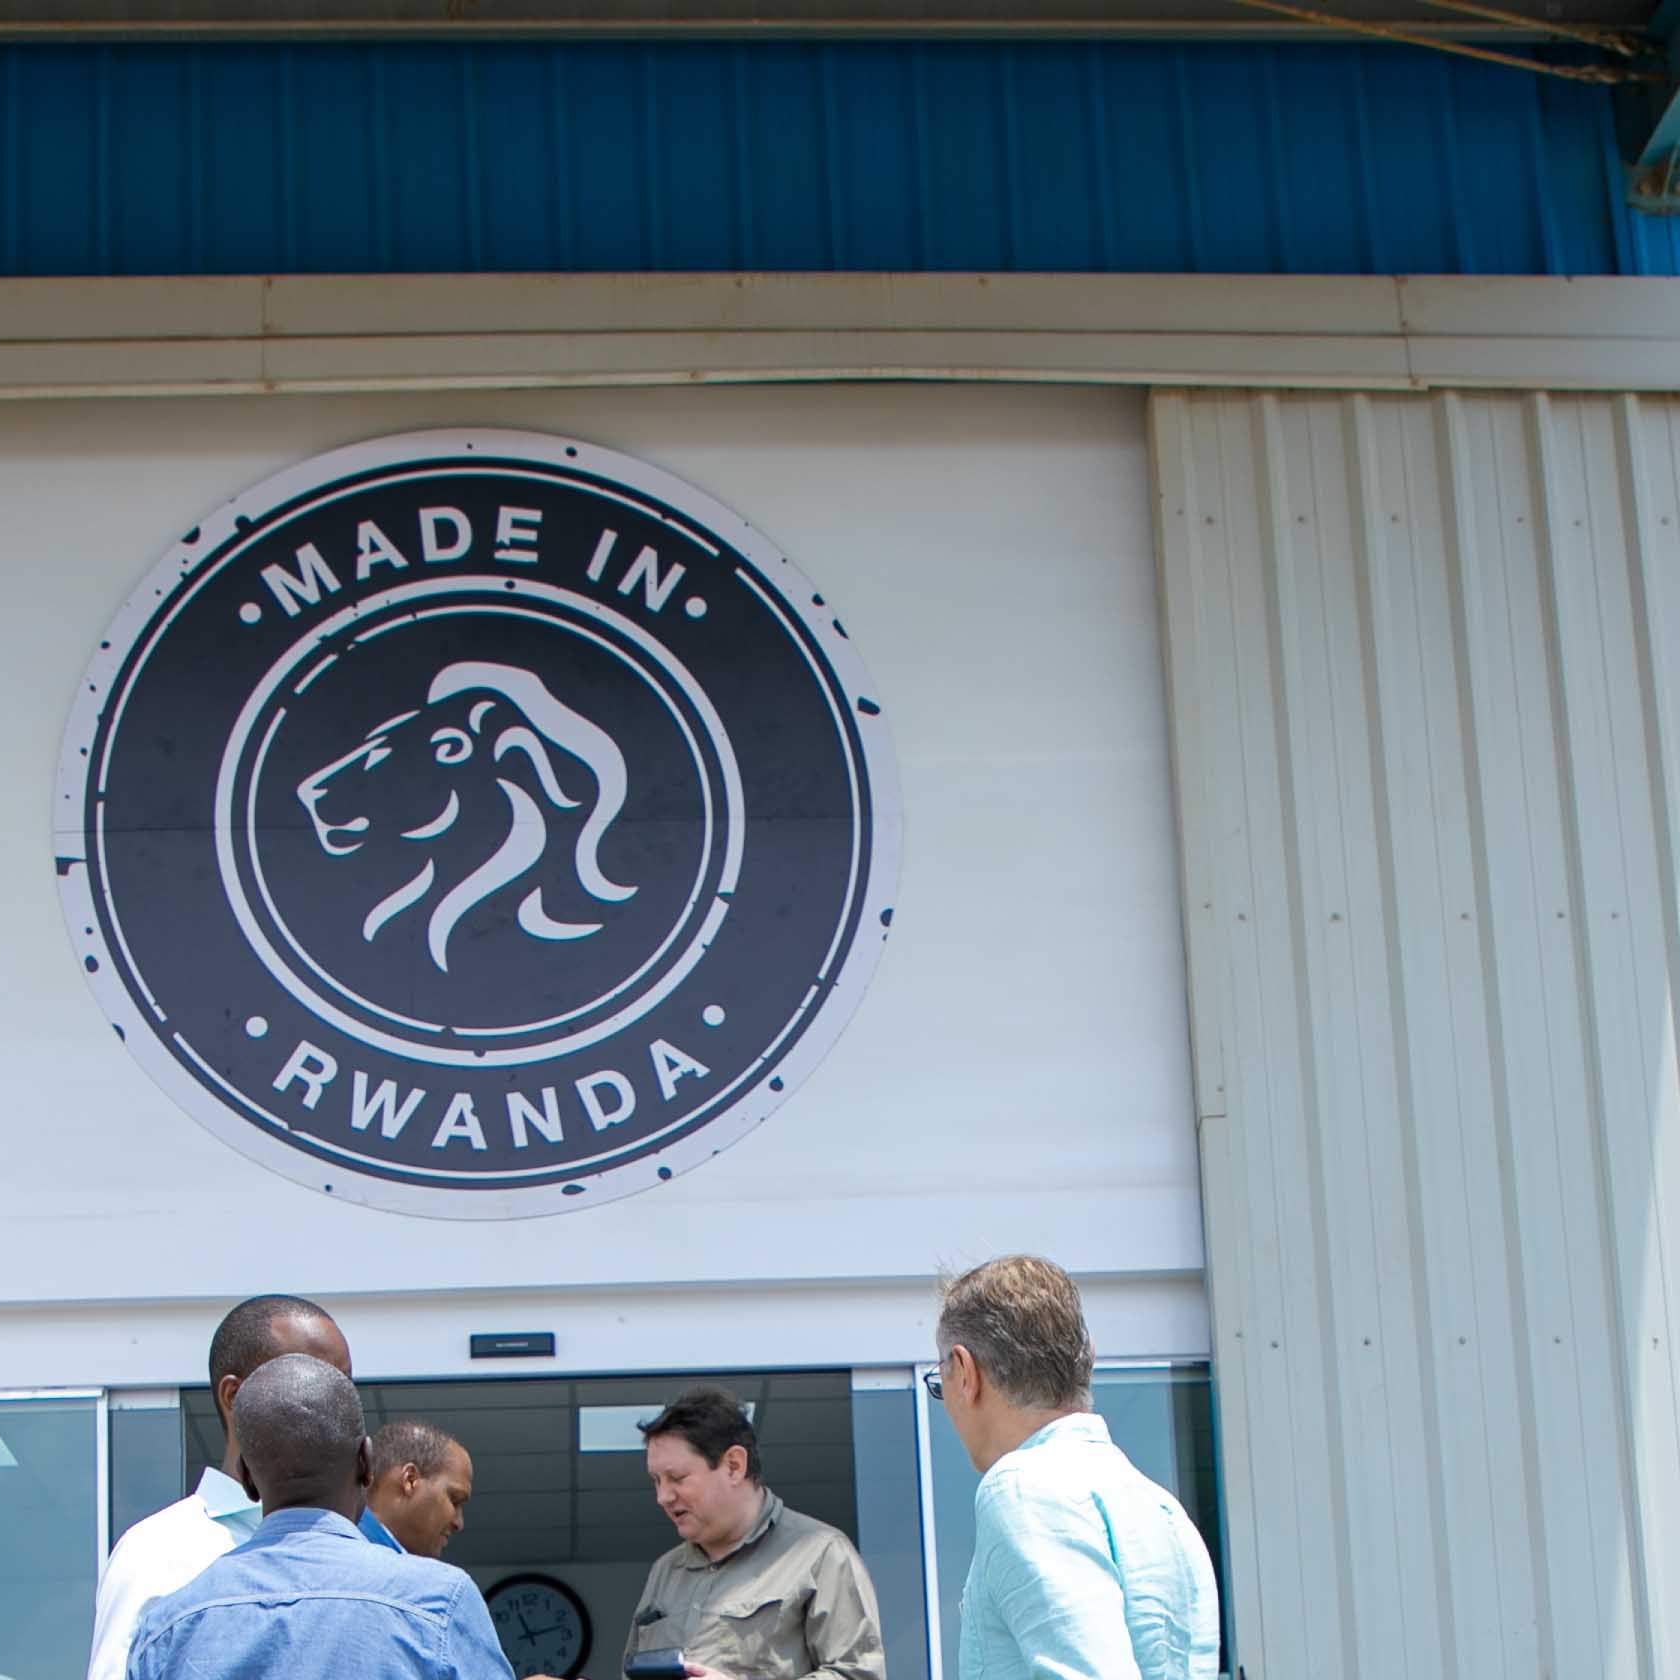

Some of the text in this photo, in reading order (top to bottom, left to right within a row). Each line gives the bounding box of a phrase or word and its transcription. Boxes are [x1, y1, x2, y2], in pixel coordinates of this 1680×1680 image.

[259, 505, 688, 617] MADE IN
[271, 1037, 712, 1151] RWANDA
[509, 1599, 520, 1612] 11
[521, 1592, 538, 1606] 12
